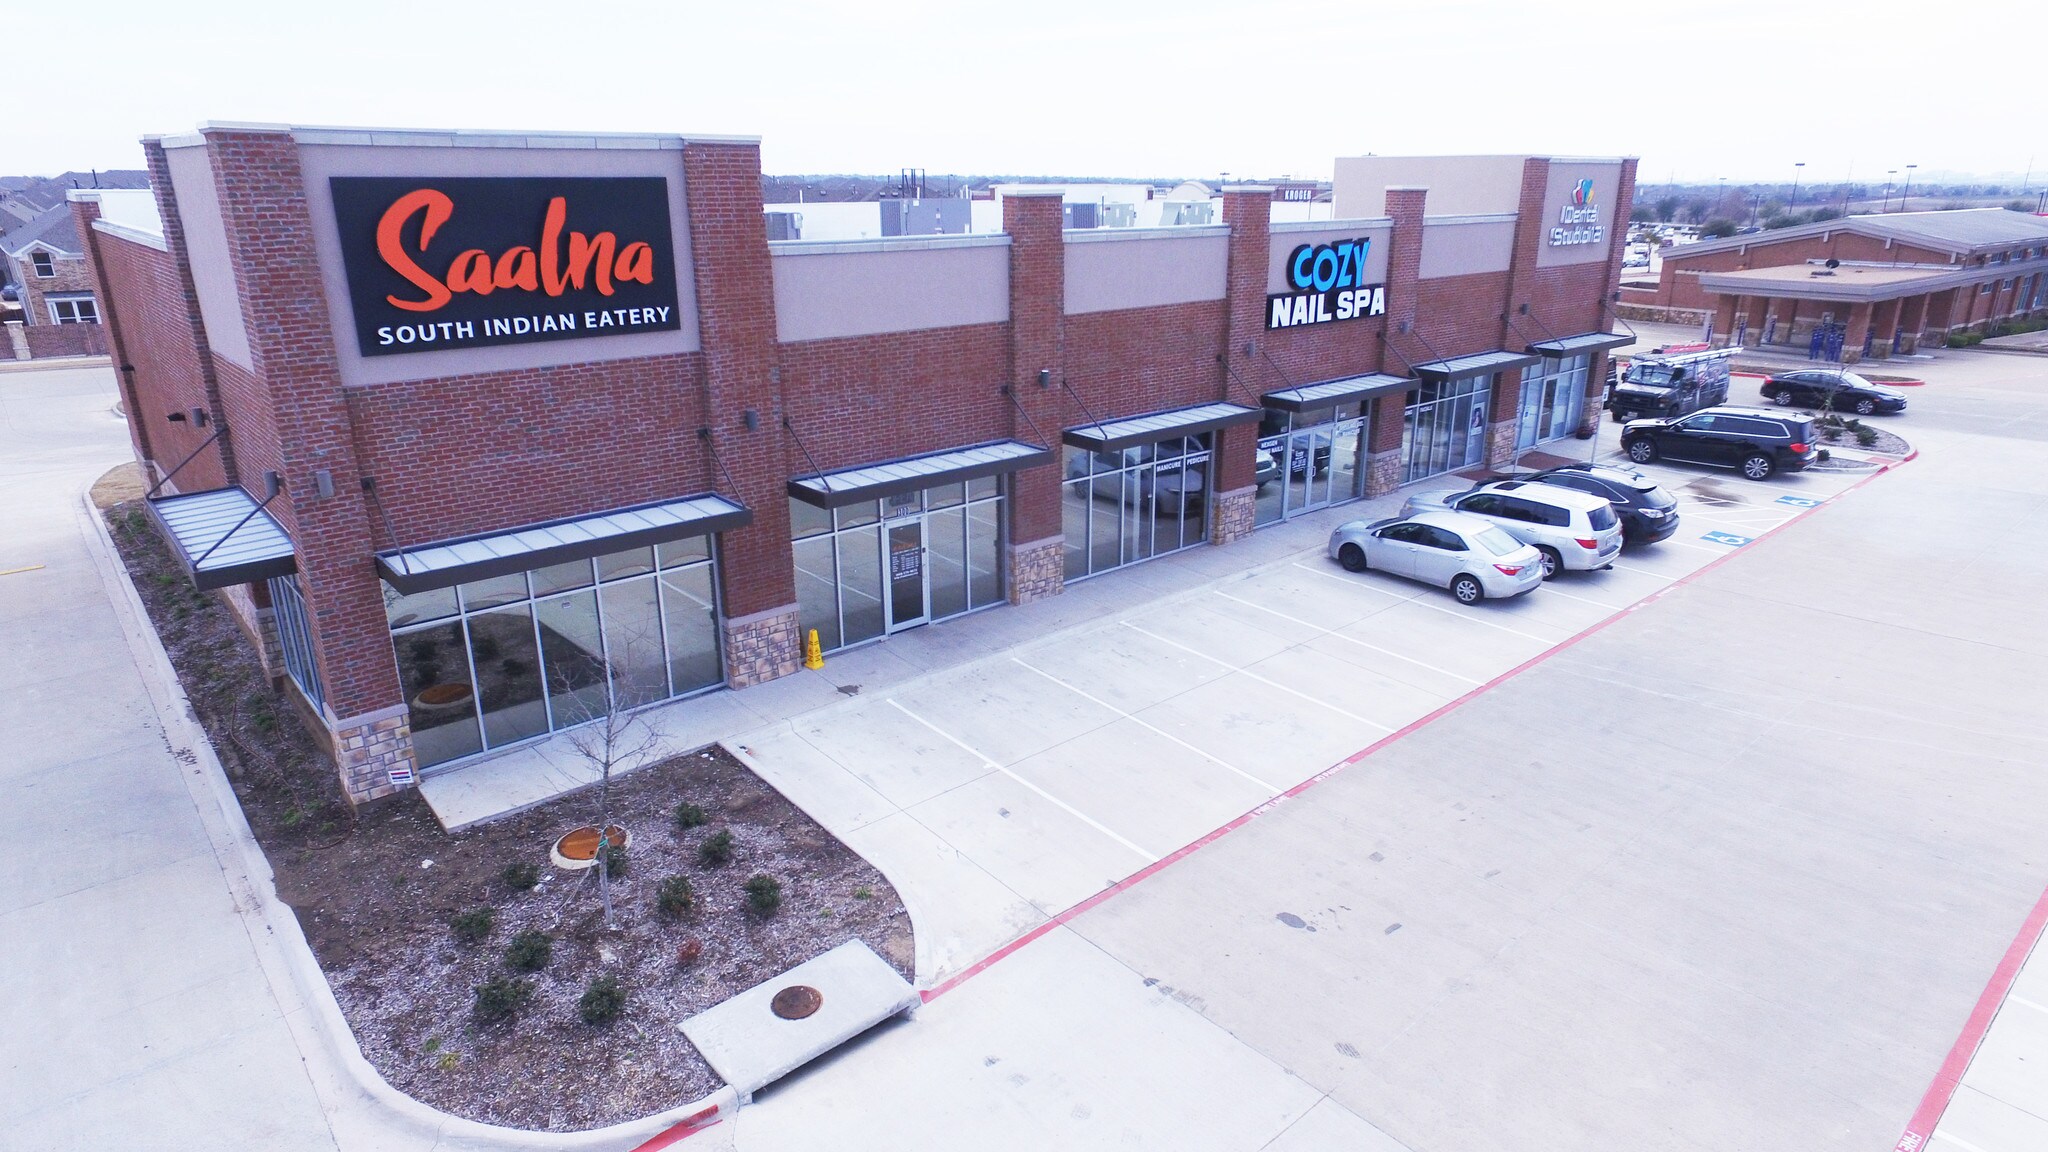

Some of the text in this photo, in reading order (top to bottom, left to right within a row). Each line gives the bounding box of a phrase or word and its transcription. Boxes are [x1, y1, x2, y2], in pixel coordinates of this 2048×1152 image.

[1284, 189, 1312, 201] KROGER
[376, 188, 654, 312] Saalna
[1290, 239, 1371, 292] COZY
[377, 306, 670, 345] SOUTH INDIAN EATERY
[1271, 287, 1385, 328] NAIL SPA
[1156, 454, 1210, 472] MANICURE PEDICURE
